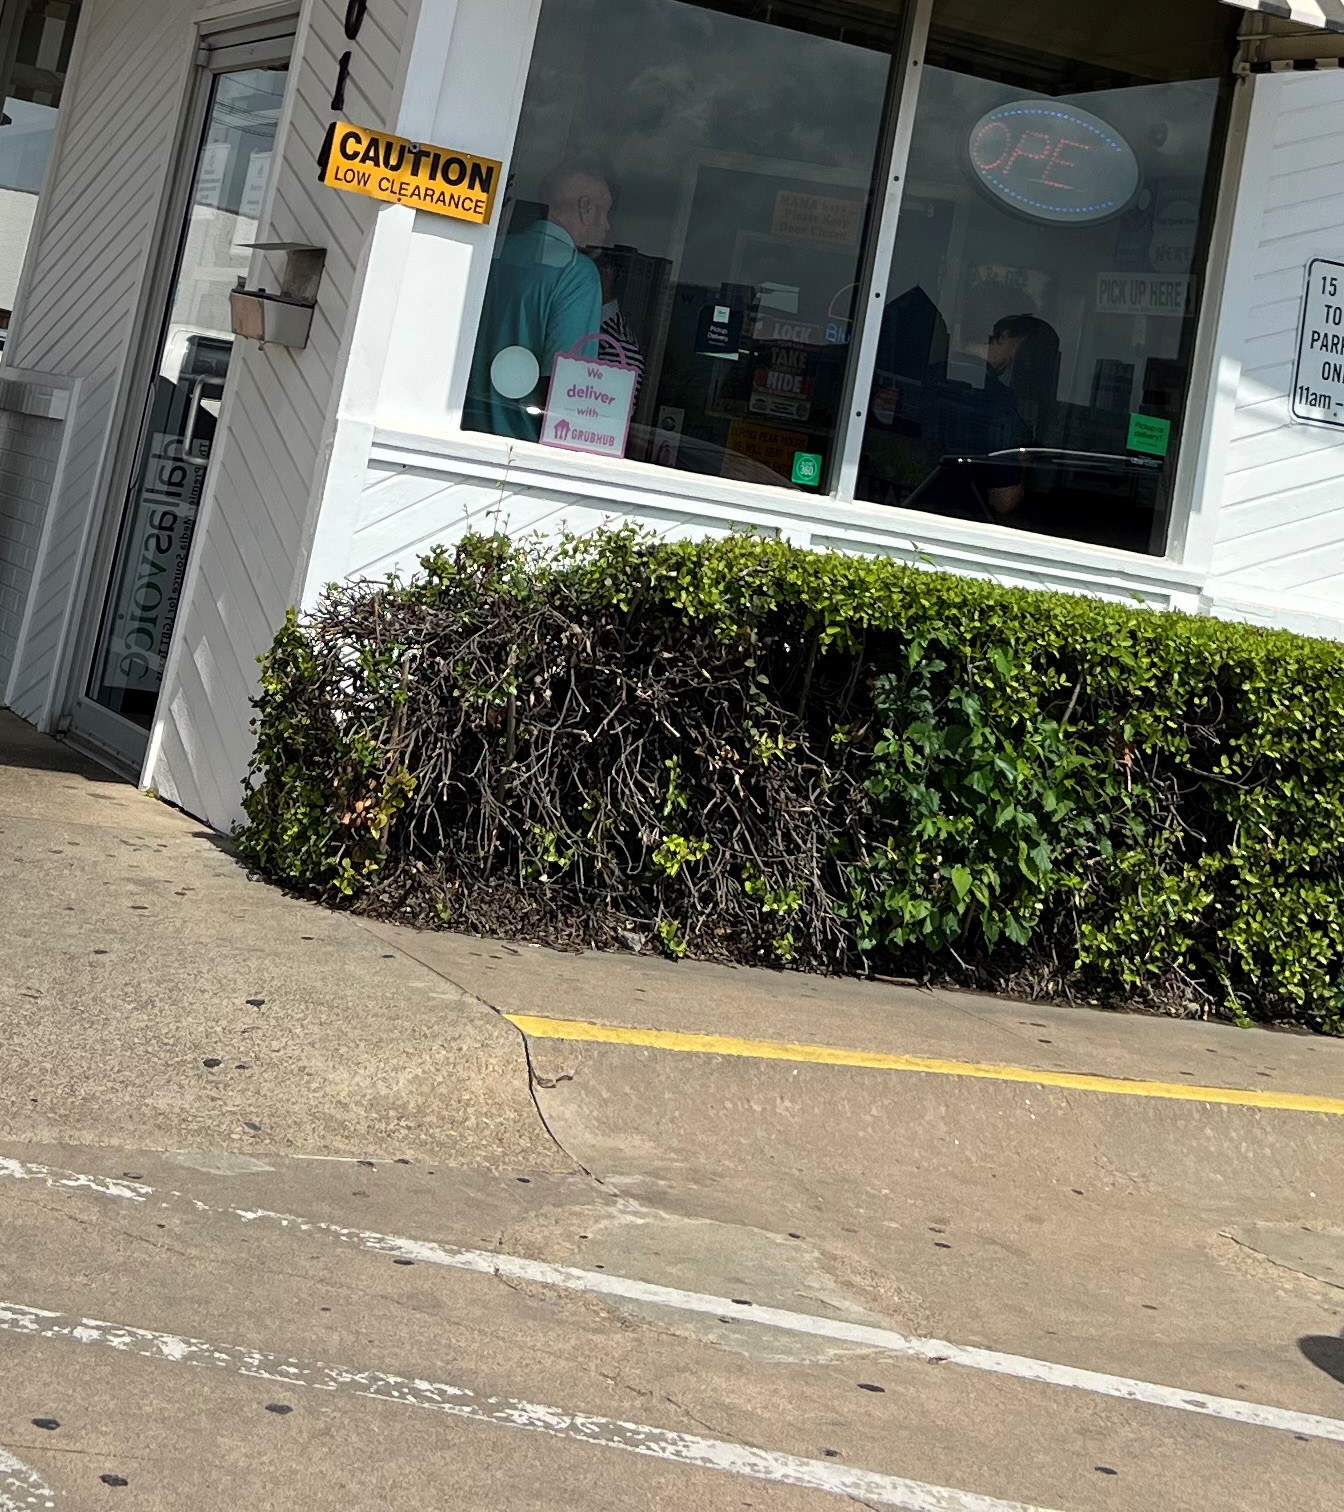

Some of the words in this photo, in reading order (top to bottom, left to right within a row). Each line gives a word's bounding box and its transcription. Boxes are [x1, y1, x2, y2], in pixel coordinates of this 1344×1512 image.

[339, 131, 494, 194] CAUTION
[334, 166, 372, 187] LOW
[378, 176, 486, 215] CLEARANCE
[1099, 279, 1126, 304] PICK
[1129, 280, 1146, 305] UP
[1149, 281, 1183, 307] HERE
[1321, 276, 1337, 297] 15
[1324, 304, 1342, 326] TO
[772, 322, 812, 343] LOCK
[771, 346, 808, 369] TAKE
[587, 366, 603, 380] We
[766, 371, 804, 394] HIDE
[566, 383, 616, 405] deliver
[1298, 385, 1332, 410] 11am
[577, 406, 599, 419] with
[571, 428, 615, 447] GRUBHUB
